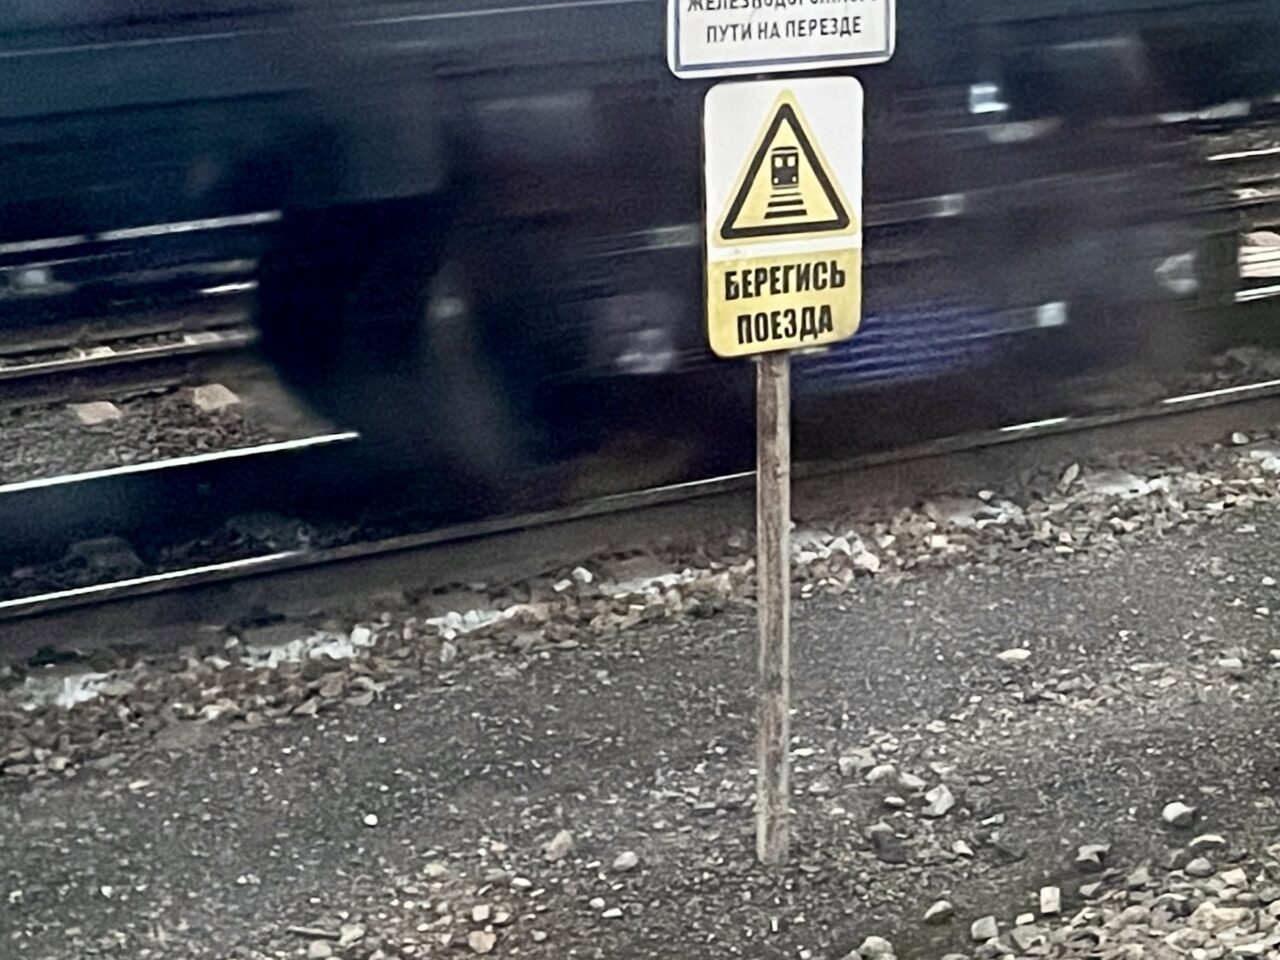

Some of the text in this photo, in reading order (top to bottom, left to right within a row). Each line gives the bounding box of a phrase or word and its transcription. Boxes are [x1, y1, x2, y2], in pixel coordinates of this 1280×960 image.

[706, 16, 863, 43] ПУТИ НА ПЕРЕЗДЕ
[724, 259, 847, 301] БЕРЕГИСЬ
[737, 304, 834, 344] ПОЕЗДА
